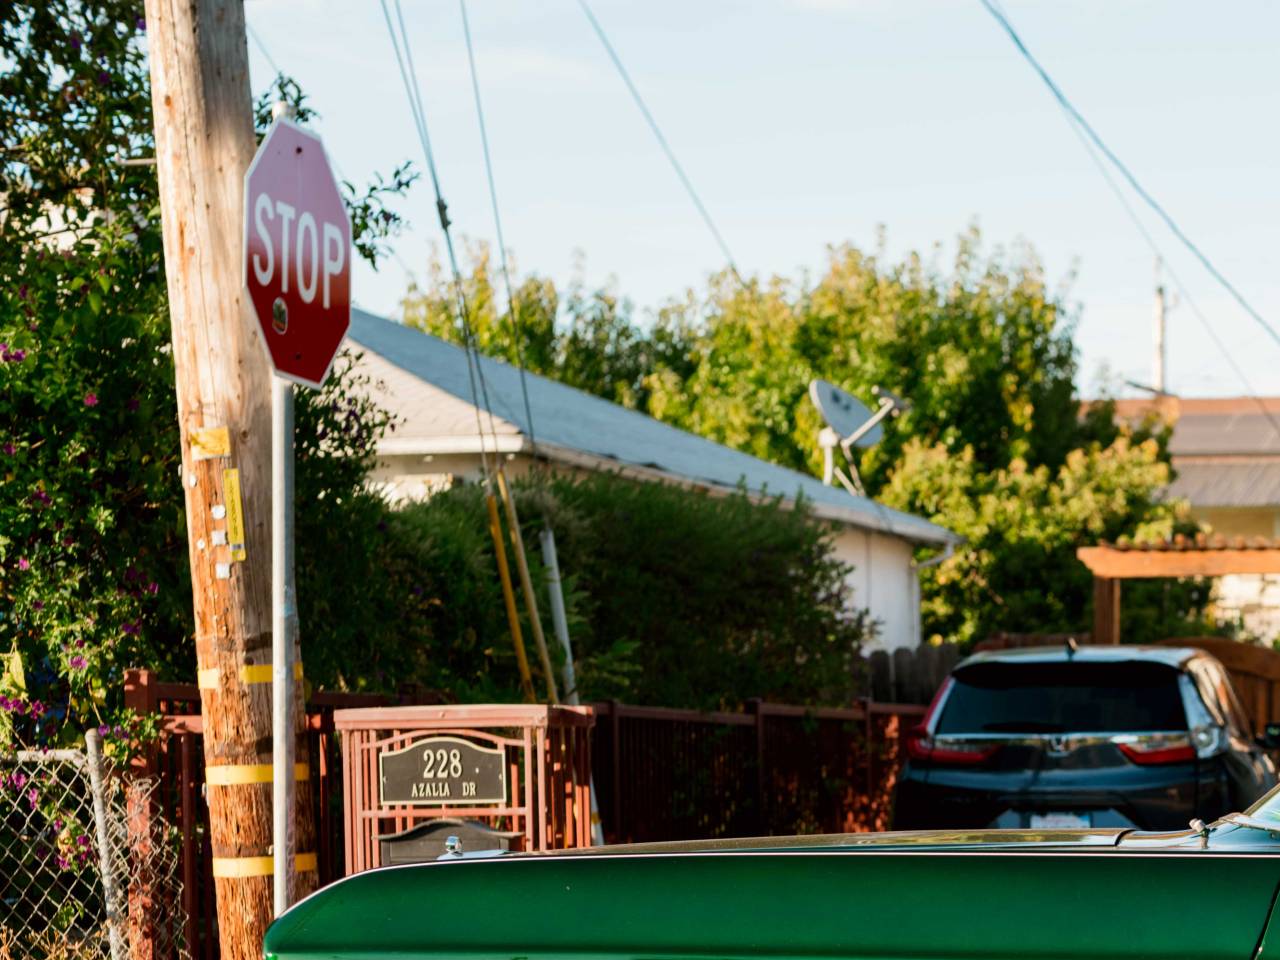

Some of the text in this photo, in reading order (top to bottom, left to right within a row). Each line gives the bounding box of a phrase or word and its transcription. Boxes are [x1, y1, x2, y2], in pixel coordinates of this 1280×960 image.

[253, 192, 345, 310] STOP
[423, 749, 463, 778] 228
[462, 781, 477, 797] DR
